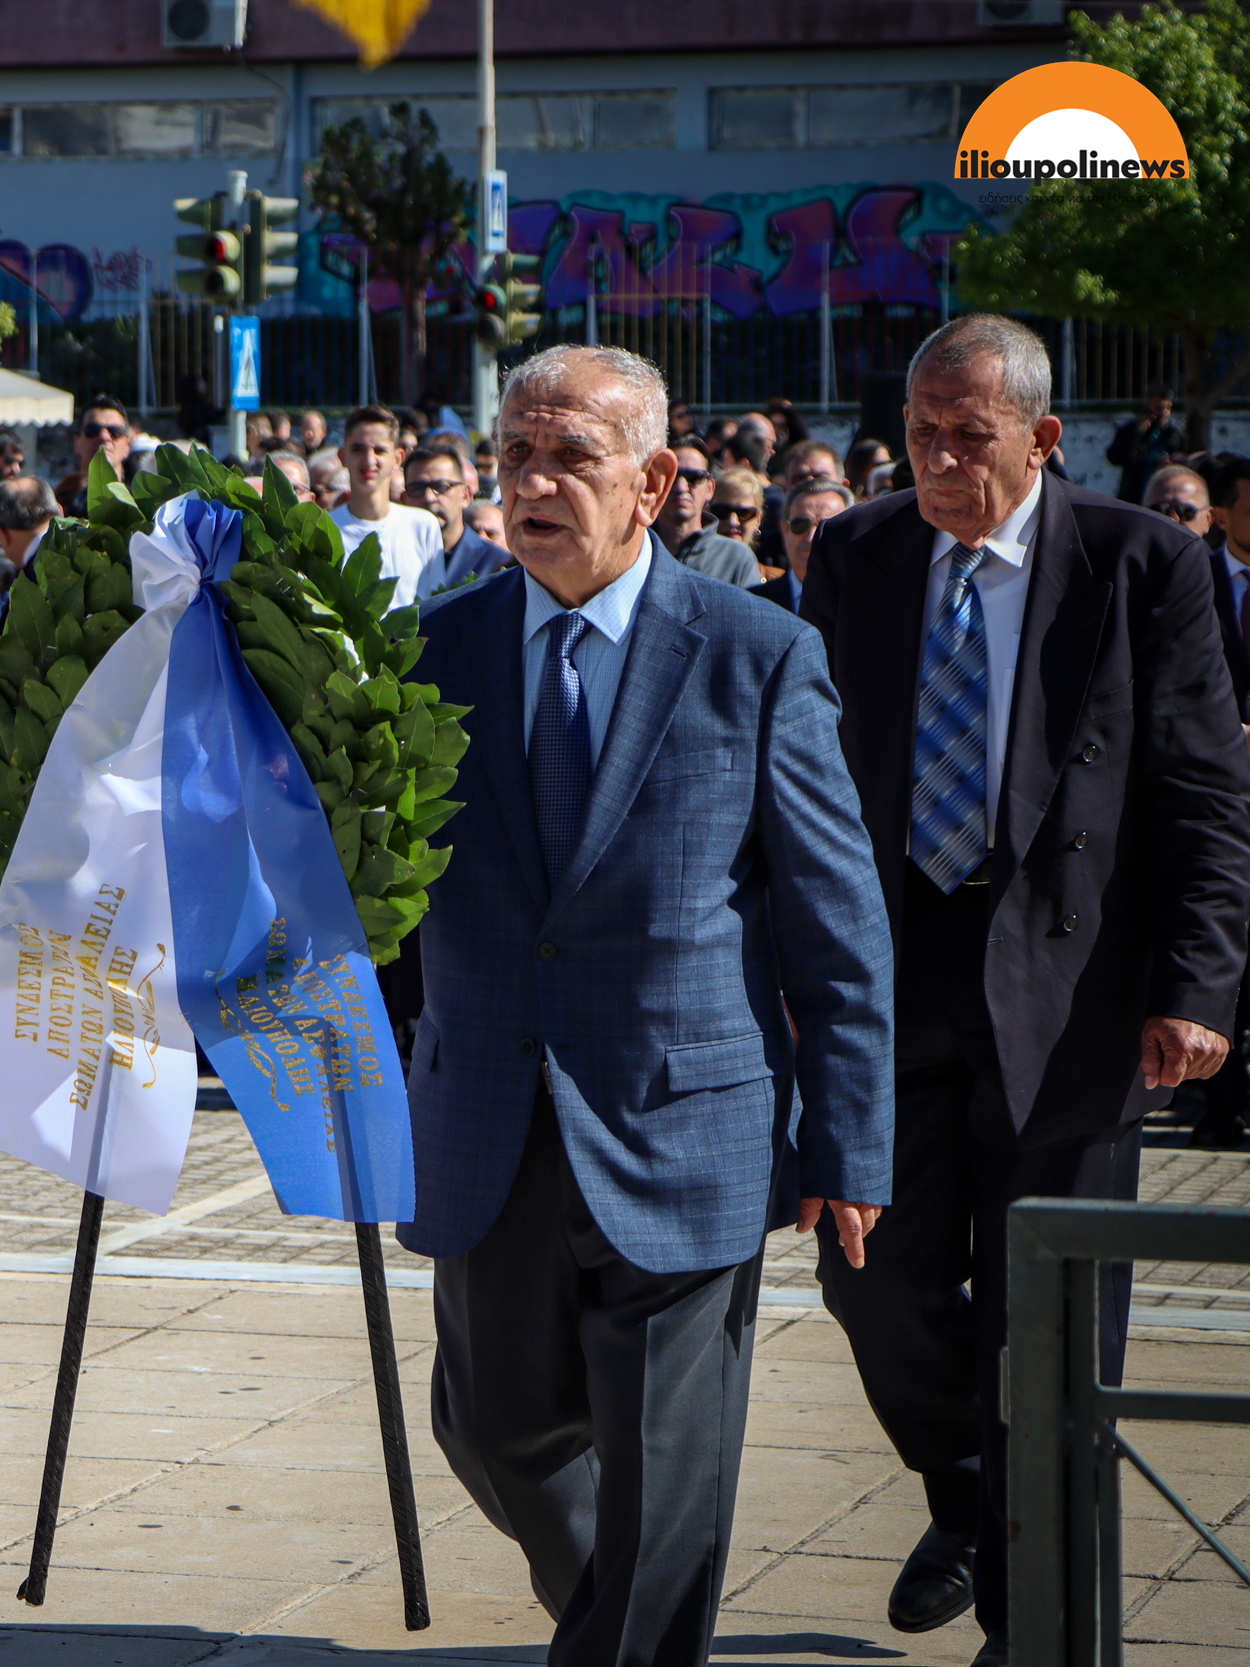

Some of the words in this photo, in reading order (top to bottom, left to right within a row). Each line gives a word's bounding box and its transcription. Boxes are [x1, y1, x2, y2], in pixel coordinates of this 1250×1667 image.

[14, 921, 44, 1043] ΣΥΝΔΕΣΜΟΣ
[46, 929, 76, 1060] ΑΠΟΣΤΡΑΤΩΝ
[75, 883, 126, 1001] ΑΣΦΑΛΕΙΑΣ
[68, 1003, 104, 1111] ΣΩΜΑΤΩΝ
[105, 945, 139, 1071] ΗΛΙΟΥΠΟΛΗΣ
[236, 975, 316, 1097] ΗΛΙΟΥΠΟΛΗΣ
[265, 916, 310, 1016] ΣΩΜΑΤΩΝ
[294, 1018, 337, 1153] ΑΣΦΑΛΕΙΑΣ
[292, 956, 354, 1092] ΑΠΟΣΤΡΑΤΩΝ
[318, 953, 383, 1087] ΣΥΝΔΕΣΜΟΣ
